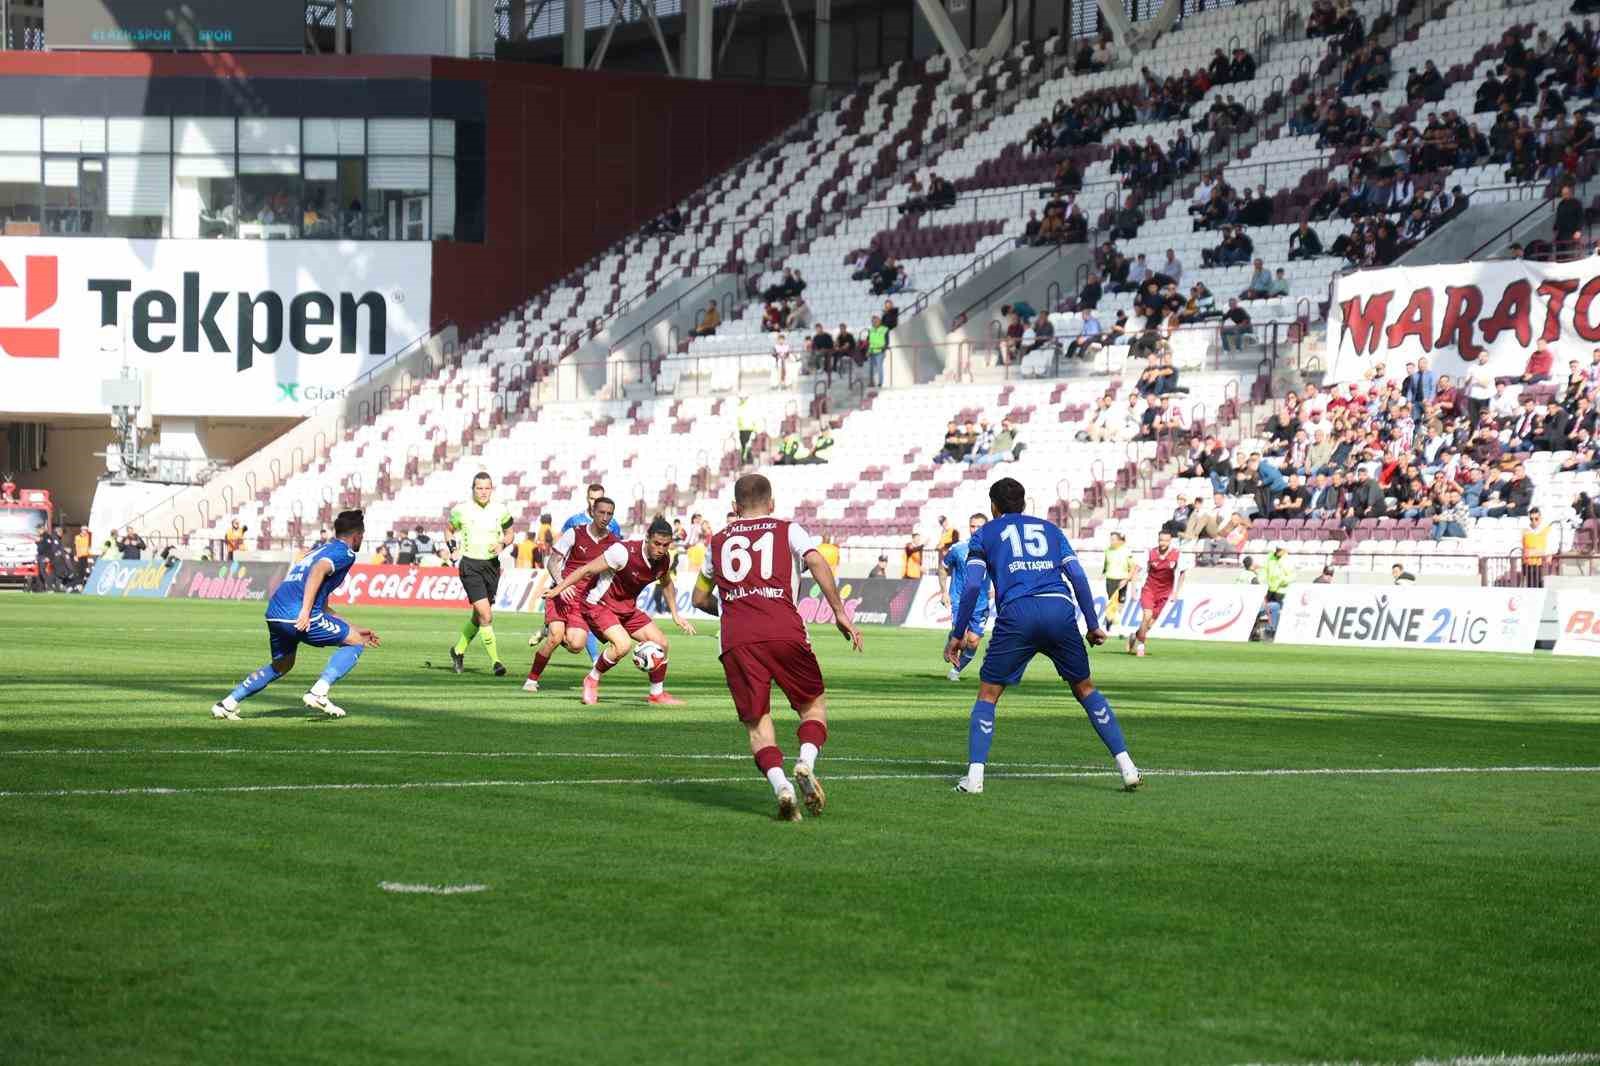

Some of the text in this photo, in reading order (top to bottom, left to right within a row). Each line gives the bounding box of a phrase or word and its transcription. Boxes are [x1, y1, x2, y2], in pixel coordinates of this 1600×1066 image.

[88, 271, 387, 372] Tekpen
[721, 531, 774, 583] 61
[1000, 523, 1049, 558] 15
[416, 575, 468, 600] KEB
[1316, 594, 1424, 642] NESİNE
